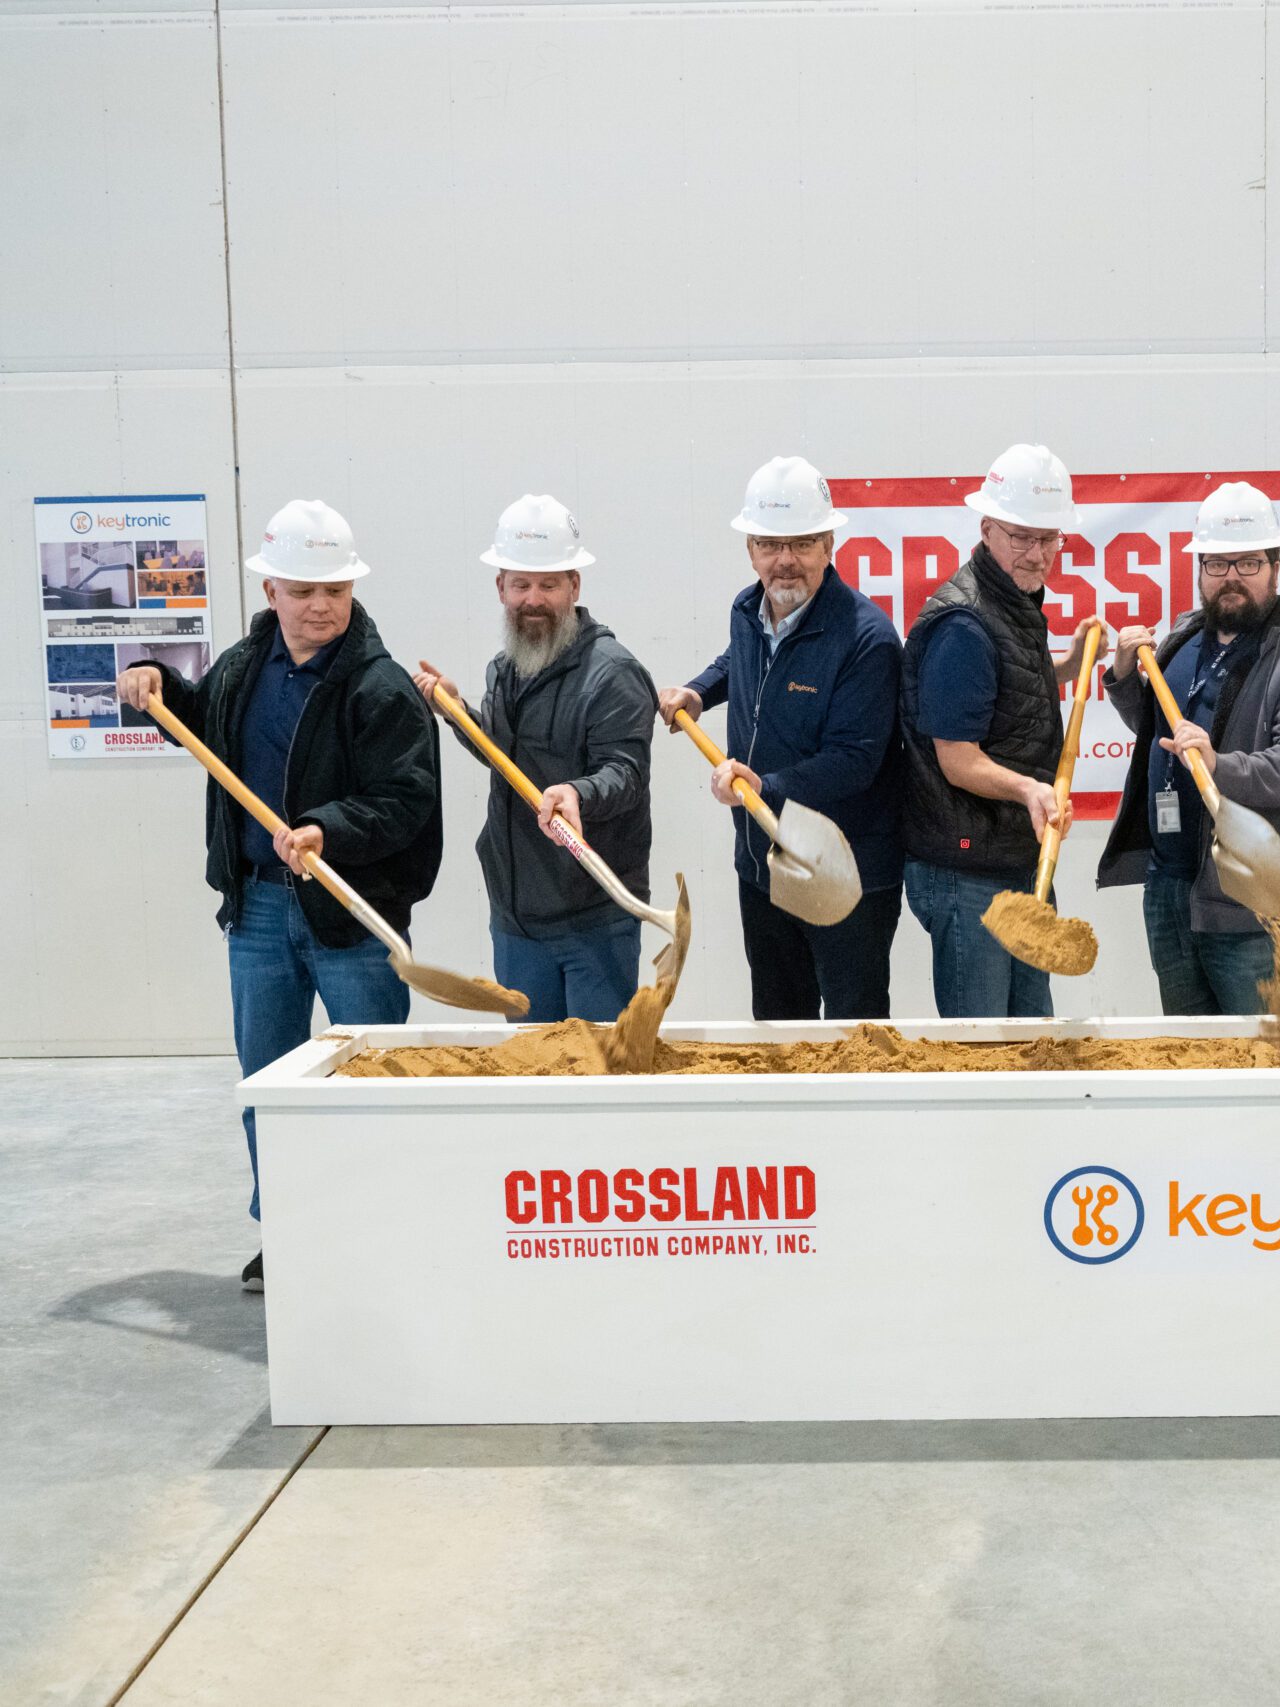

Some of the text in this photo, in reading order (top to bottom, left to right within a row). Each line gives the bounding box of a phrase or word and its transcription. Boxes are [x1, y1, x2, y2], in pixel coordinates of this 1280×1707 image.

[97, 513, 171, 531] keytronic
[504, 1165, 817, 1224] CROSSLAND
[507, 1234, 817, 1259] CONSTRUCTION COMPANY, INC.
